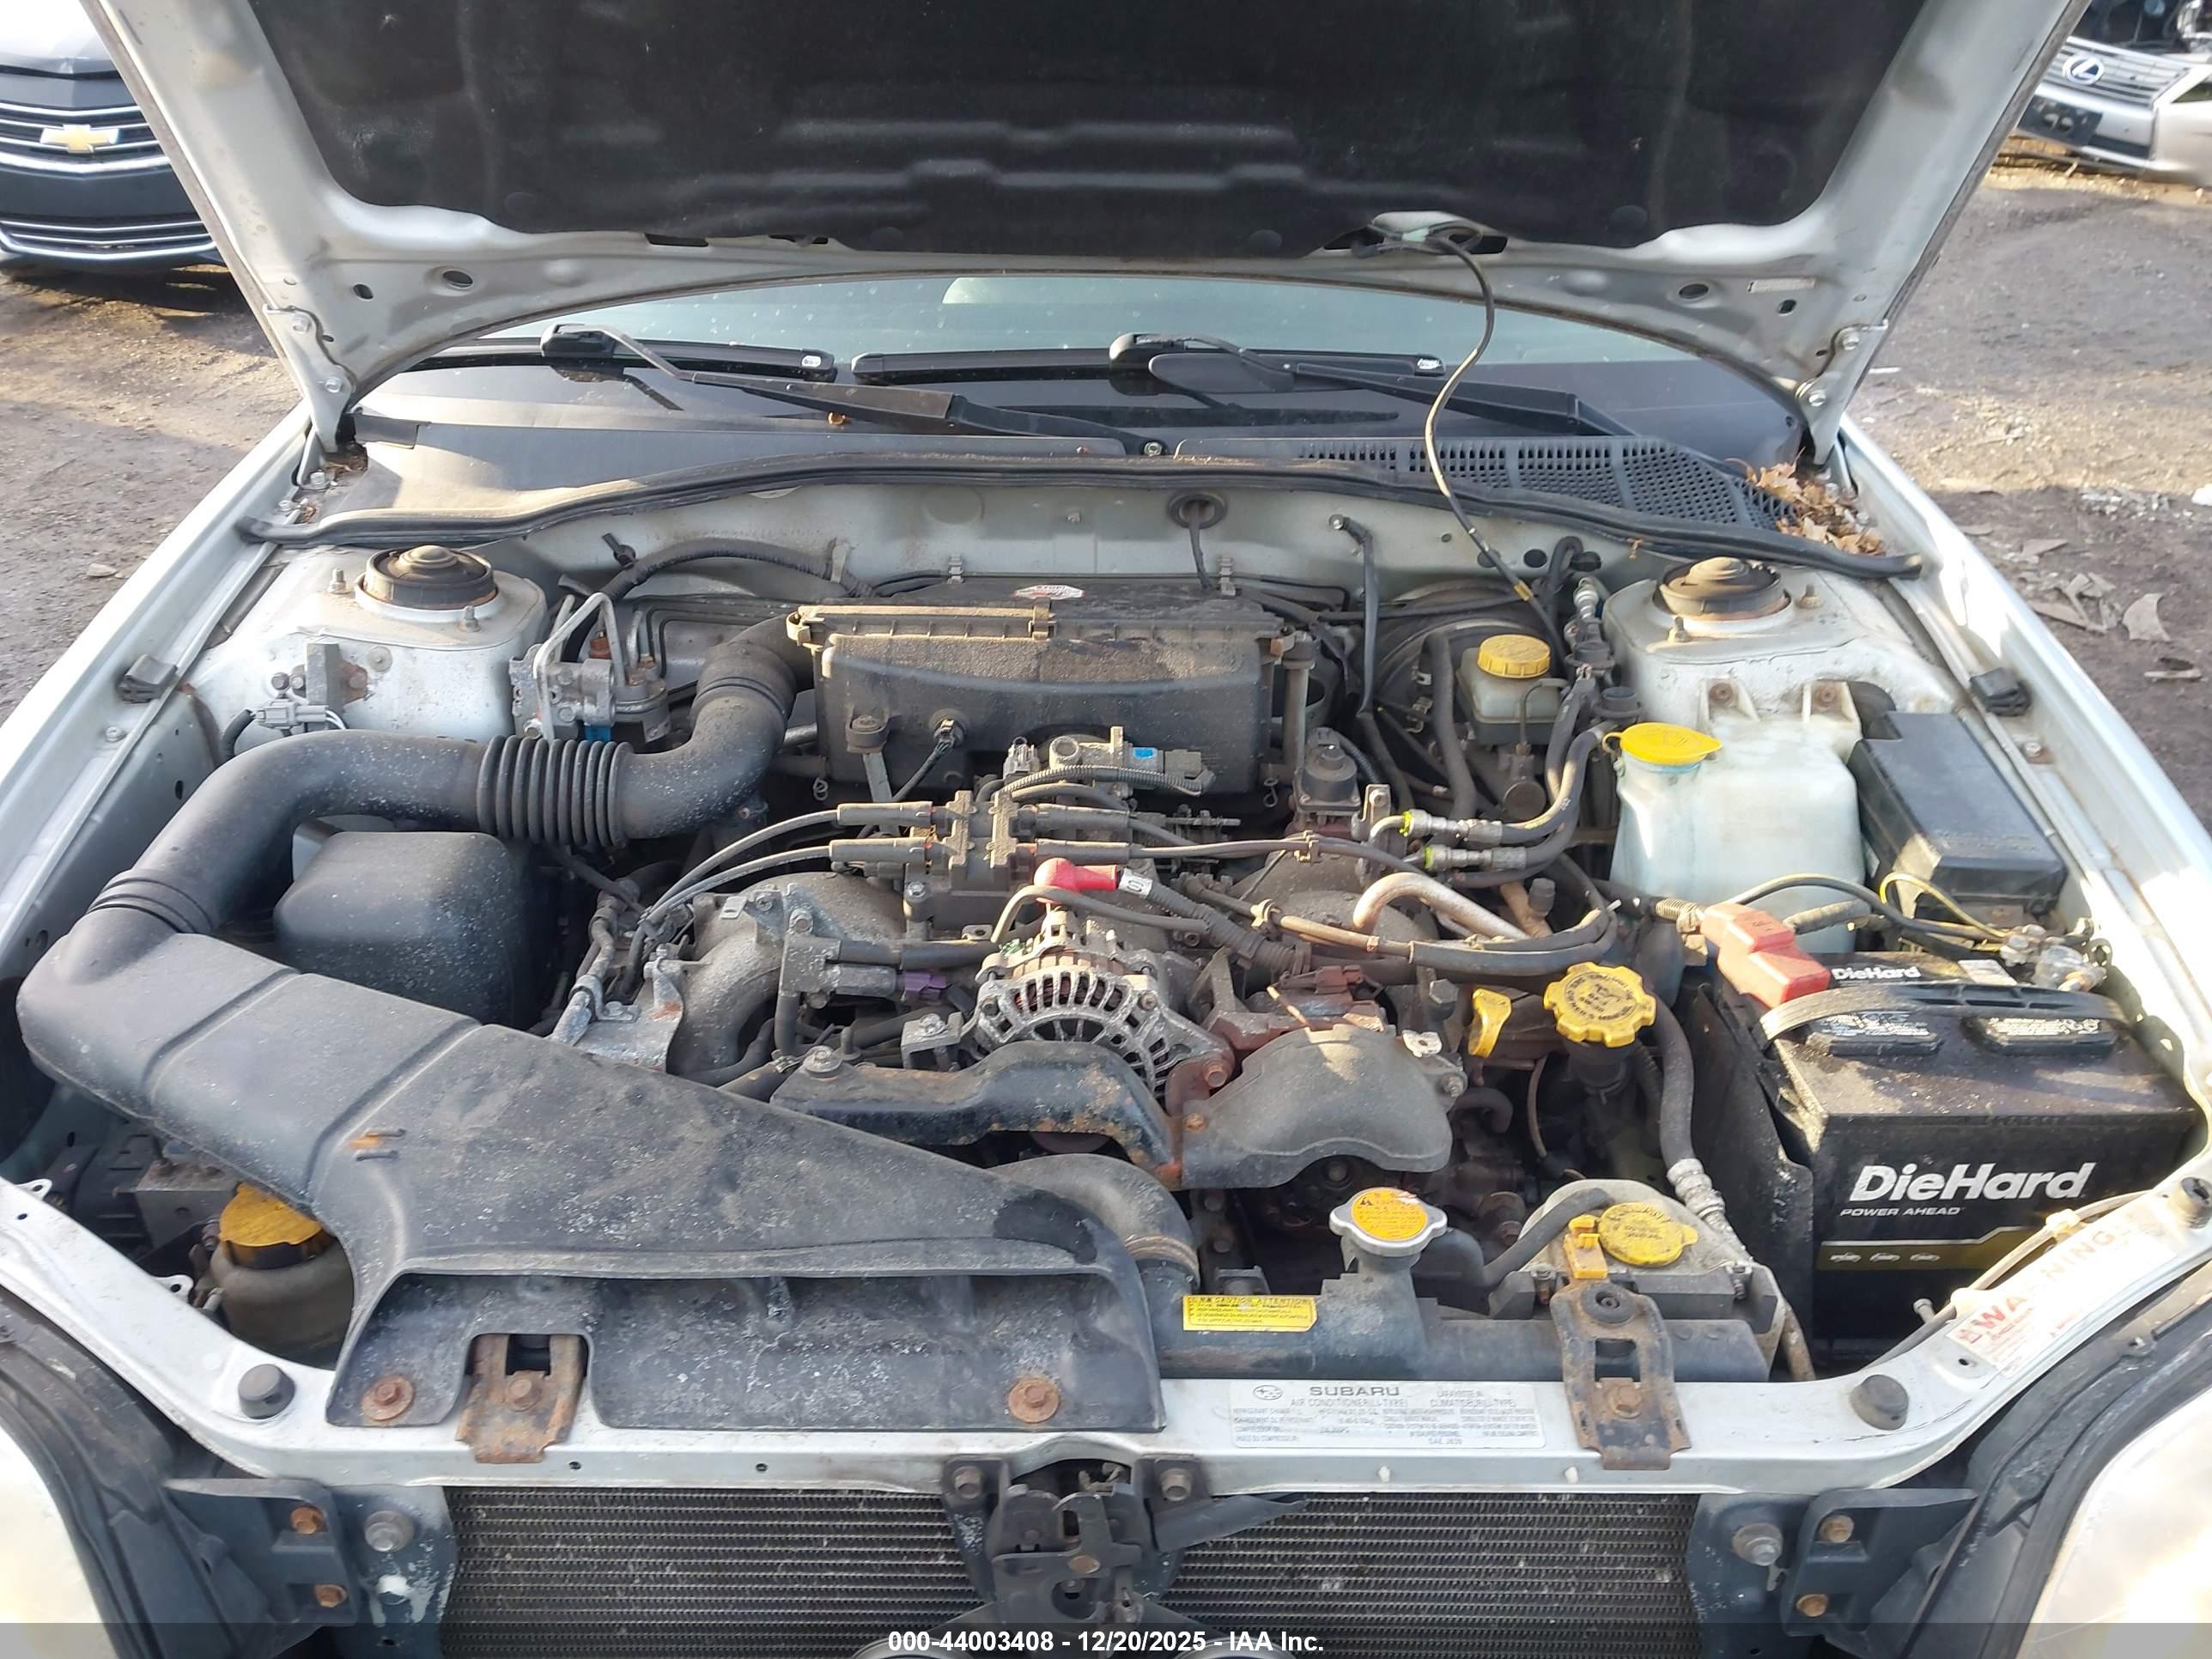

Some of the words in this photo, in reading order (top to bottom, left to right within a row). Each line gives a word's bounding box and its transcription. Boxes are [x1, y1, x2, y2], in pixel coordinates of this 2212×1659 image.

[1831, 965, 1922, 980] DieHard
[1848, 1162, 2096, 1202] DieHard
[1839, 1207, 1899, 1217] POWER
[1903, 1206, 1961, 1216] AHEAD
[1971, 1230, 2115, 1329] WANING
[1310, 1386, 1401, 1397] SUBARU
